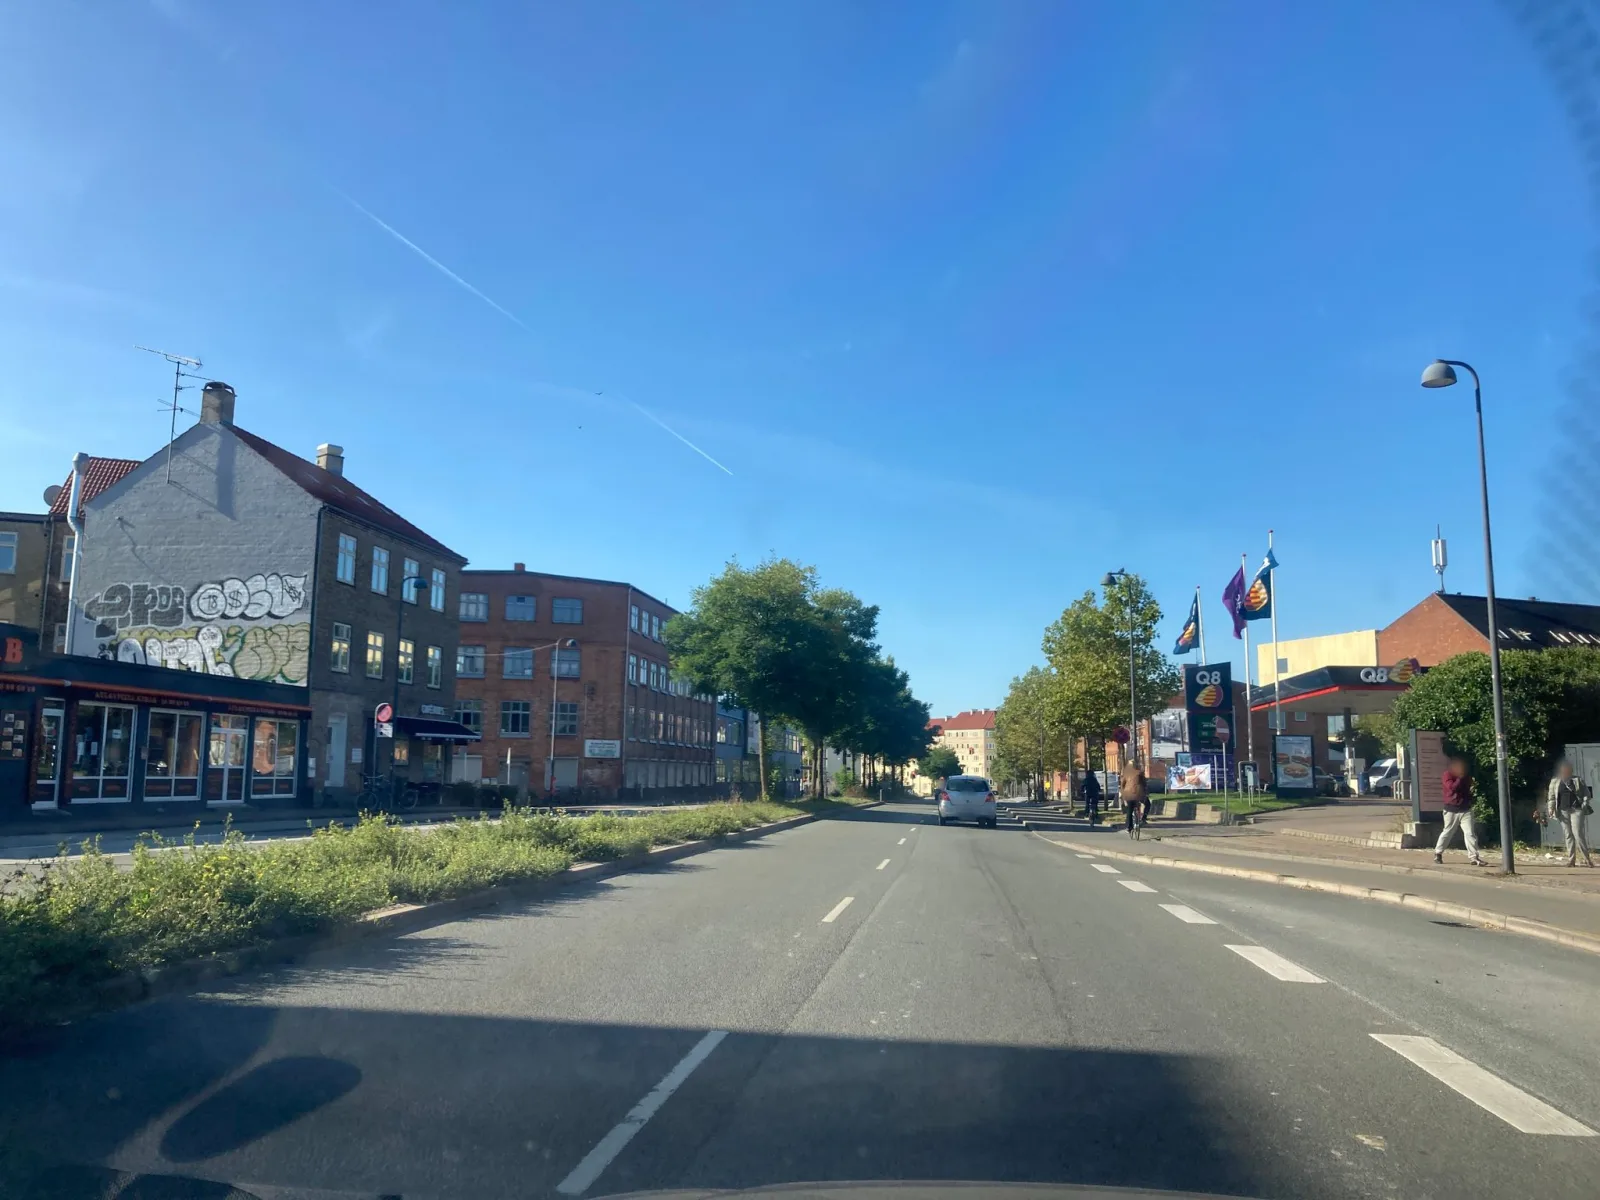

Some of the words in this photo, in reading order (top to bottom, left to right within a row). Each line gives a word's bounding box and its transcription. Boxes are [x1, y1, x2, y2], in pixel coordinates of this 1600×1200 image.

[0, 637, 23, 664] B
[1196, 670, 1221, 685] Q8
[1360, 667, 1388, 683] Q8
